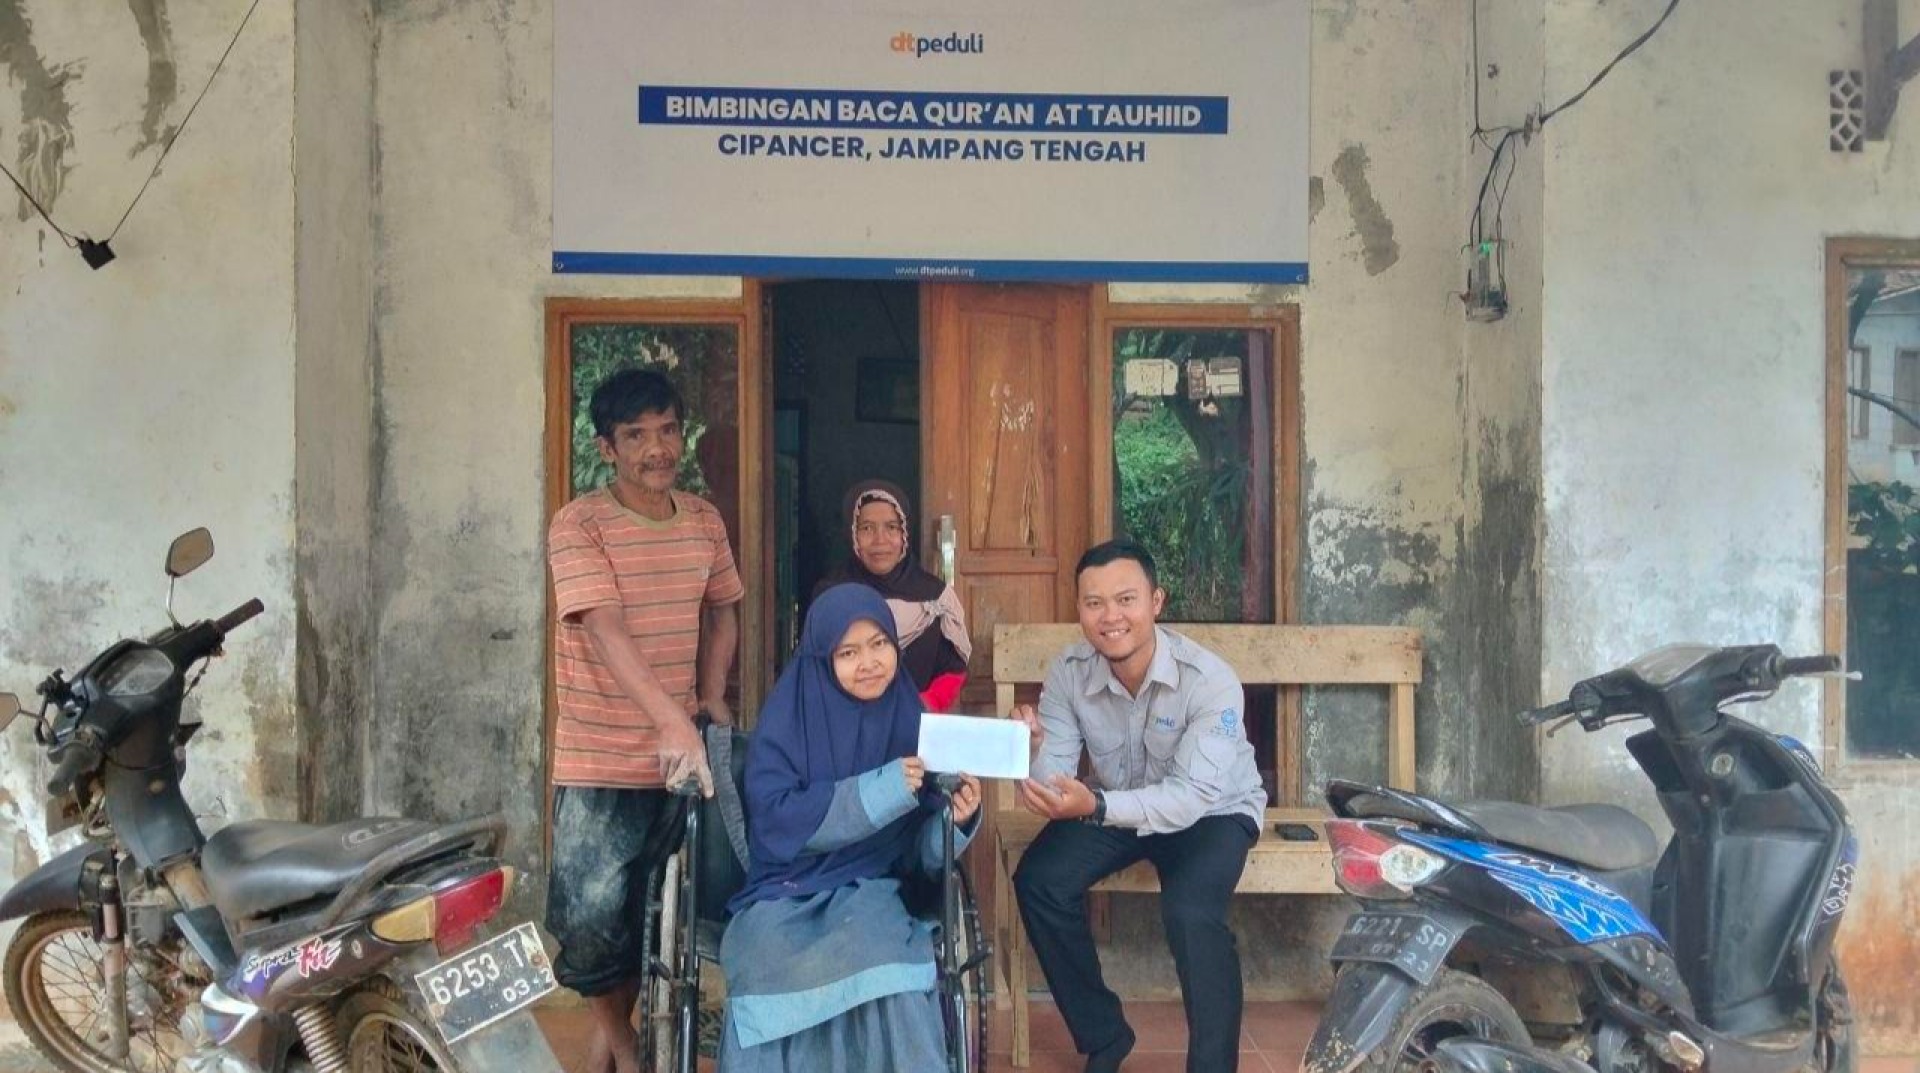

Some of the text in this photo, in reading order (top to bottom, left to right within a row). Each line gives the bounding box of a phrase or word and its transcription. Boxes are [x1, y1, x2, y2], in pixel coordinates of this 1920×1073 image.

[890, 31, 984, 58] dtpeduli
[666, 95, 832, 121] BIMBINGAN
[837, 100, 918, 123] BACA
[1045, 104, 1083, 125] AT
[1087, 104, 1202, 127] TAUHIID
[717, 133, 1146, 162] CIPANCER, JAMPANG TENGAH
[1416, 924, 1448, 952] SP
[428, 952, 501, 1005] 6253
